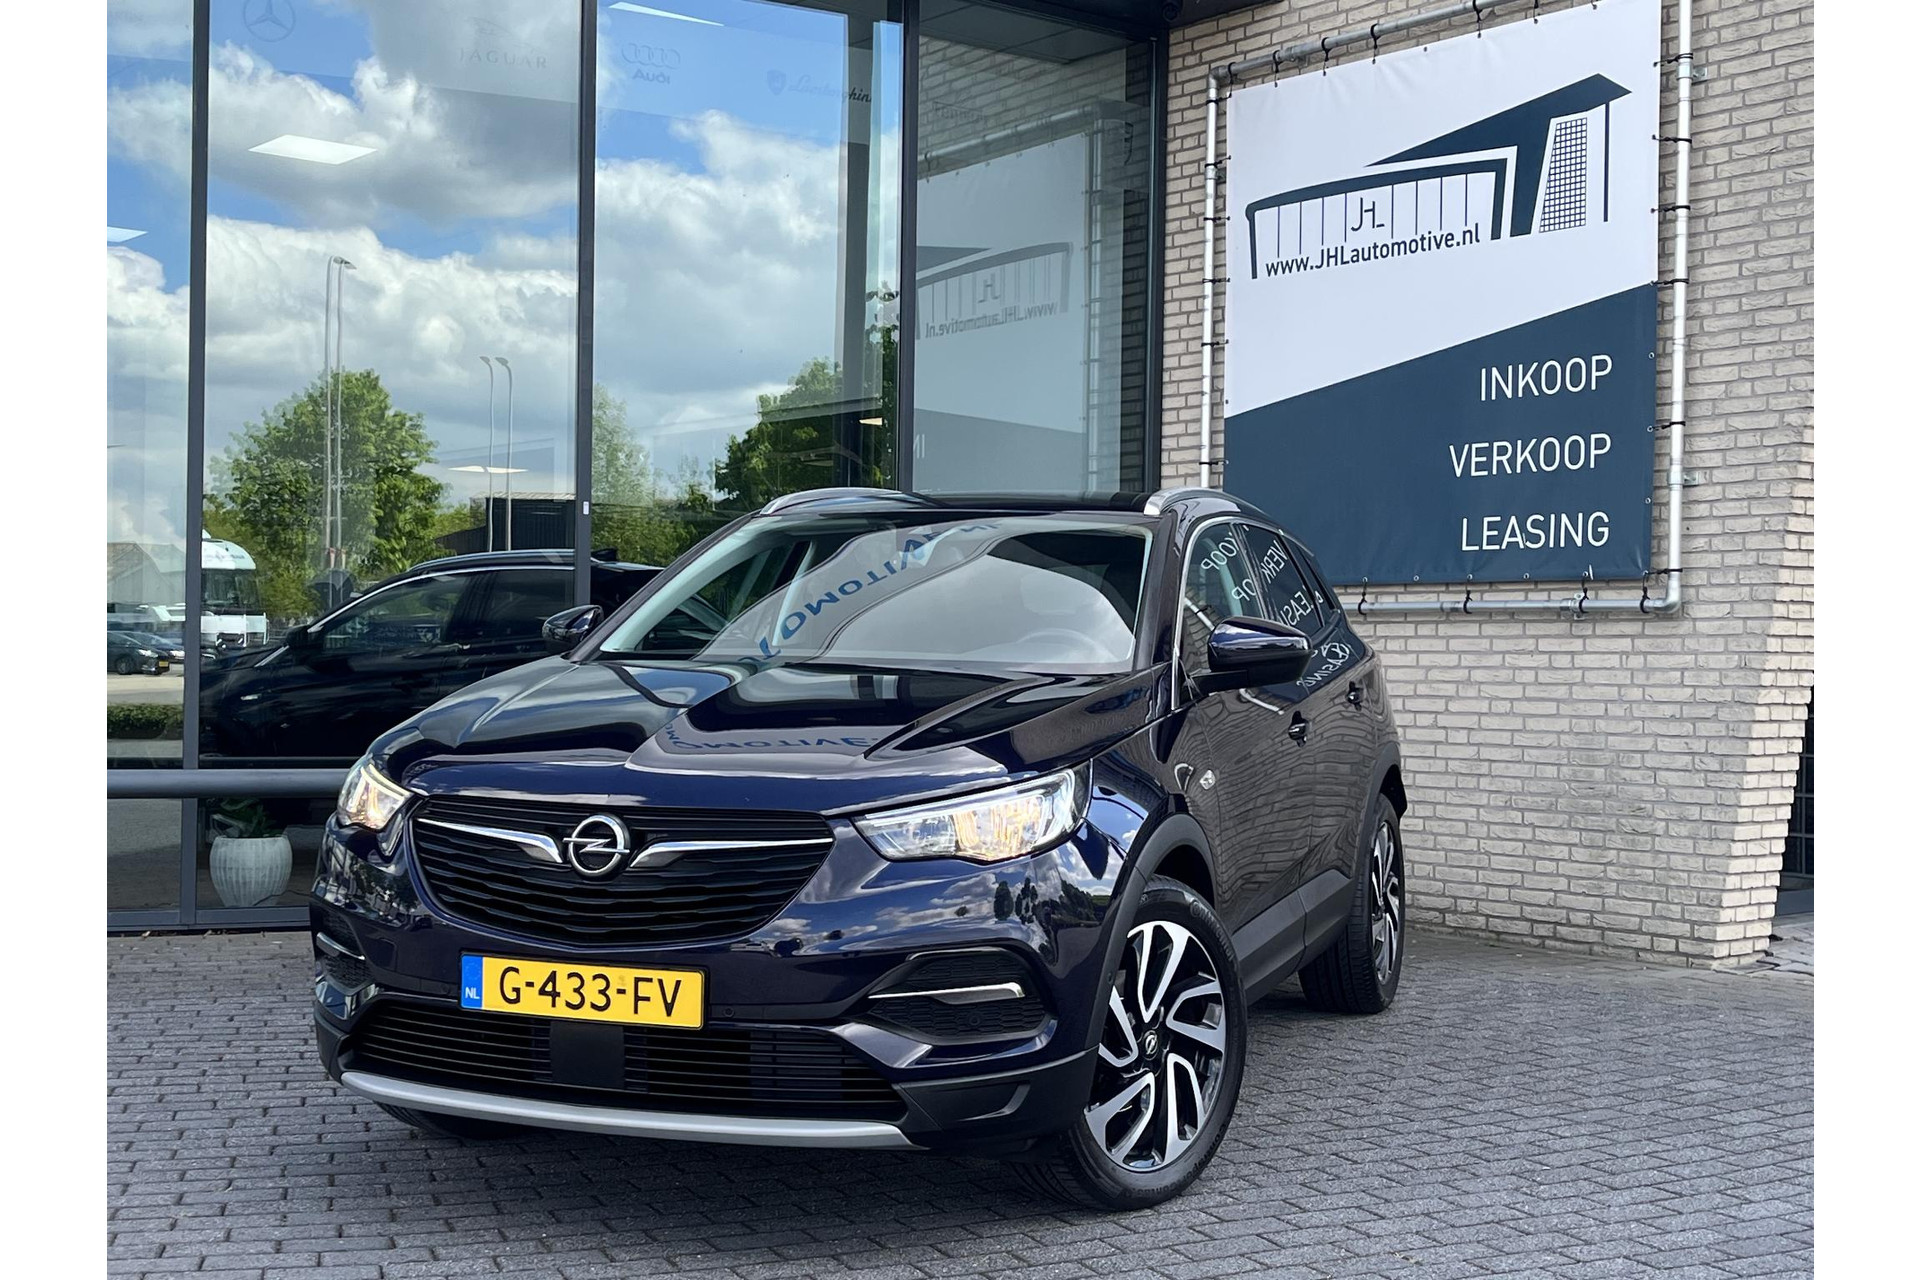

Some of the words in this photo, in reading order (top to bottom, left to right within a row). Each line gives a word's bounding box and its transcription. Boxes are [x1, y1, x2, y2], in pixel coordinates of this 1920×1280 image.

[458, 47, 548, 70] JAGUAR
[1265, 222, 1480, 277] www.JHLautomotive.nl
[1481, 354, 1613, 401] INKOOP
[1449, 433, 1611, 478] VERKOOP
[1461, 511, 1609, 551] LEASING
[465, 986, 480, 1000] NL
[499, 966, 682, 1017] G-433-FV
